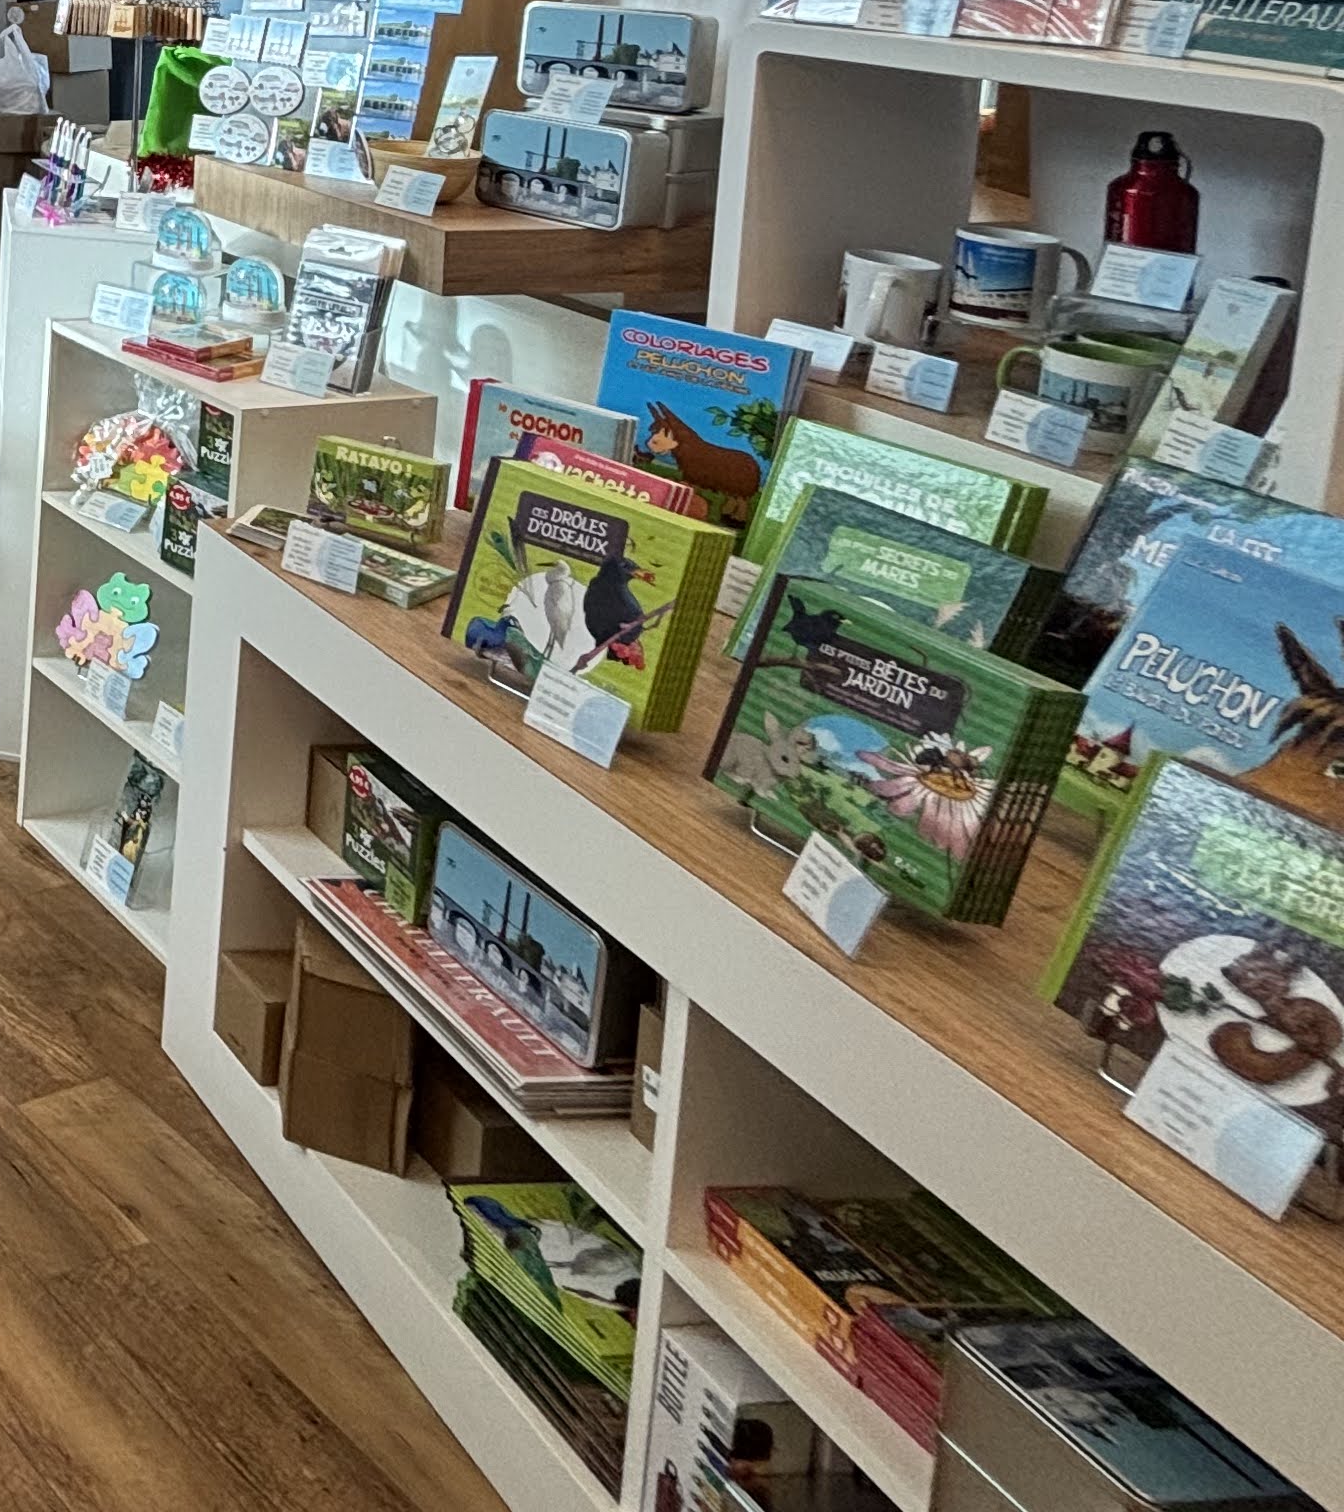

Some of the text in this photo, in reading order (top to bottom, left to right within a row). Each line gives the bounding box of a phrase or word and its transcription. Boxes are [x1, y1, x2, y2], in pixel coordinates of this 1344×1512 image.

[622, 328, 770, 373] COLORIAGES
[637, 349, 746, 385] PELUCHON
[200, 446, 231, 465] Puzzl
[336, 446, 403, 475] RATAYO
[527, 517, 609, 555] D'OISEAUX
[551, 507, 609, 537] DRÔLES
[164, 539, 196, 559] Puzzl
[876, 545, 942, 576] SECRETS
[860, 558, 921, 588] MARES
[819, 643, 835, 657] LES
[872, 659, 929, 694] BÊTES
[1117, 631, 1282, 730] PELUCHON
[842, 667, 913, 709] JARDIN
[657, 1339, 689, 1424] BOTTLE
